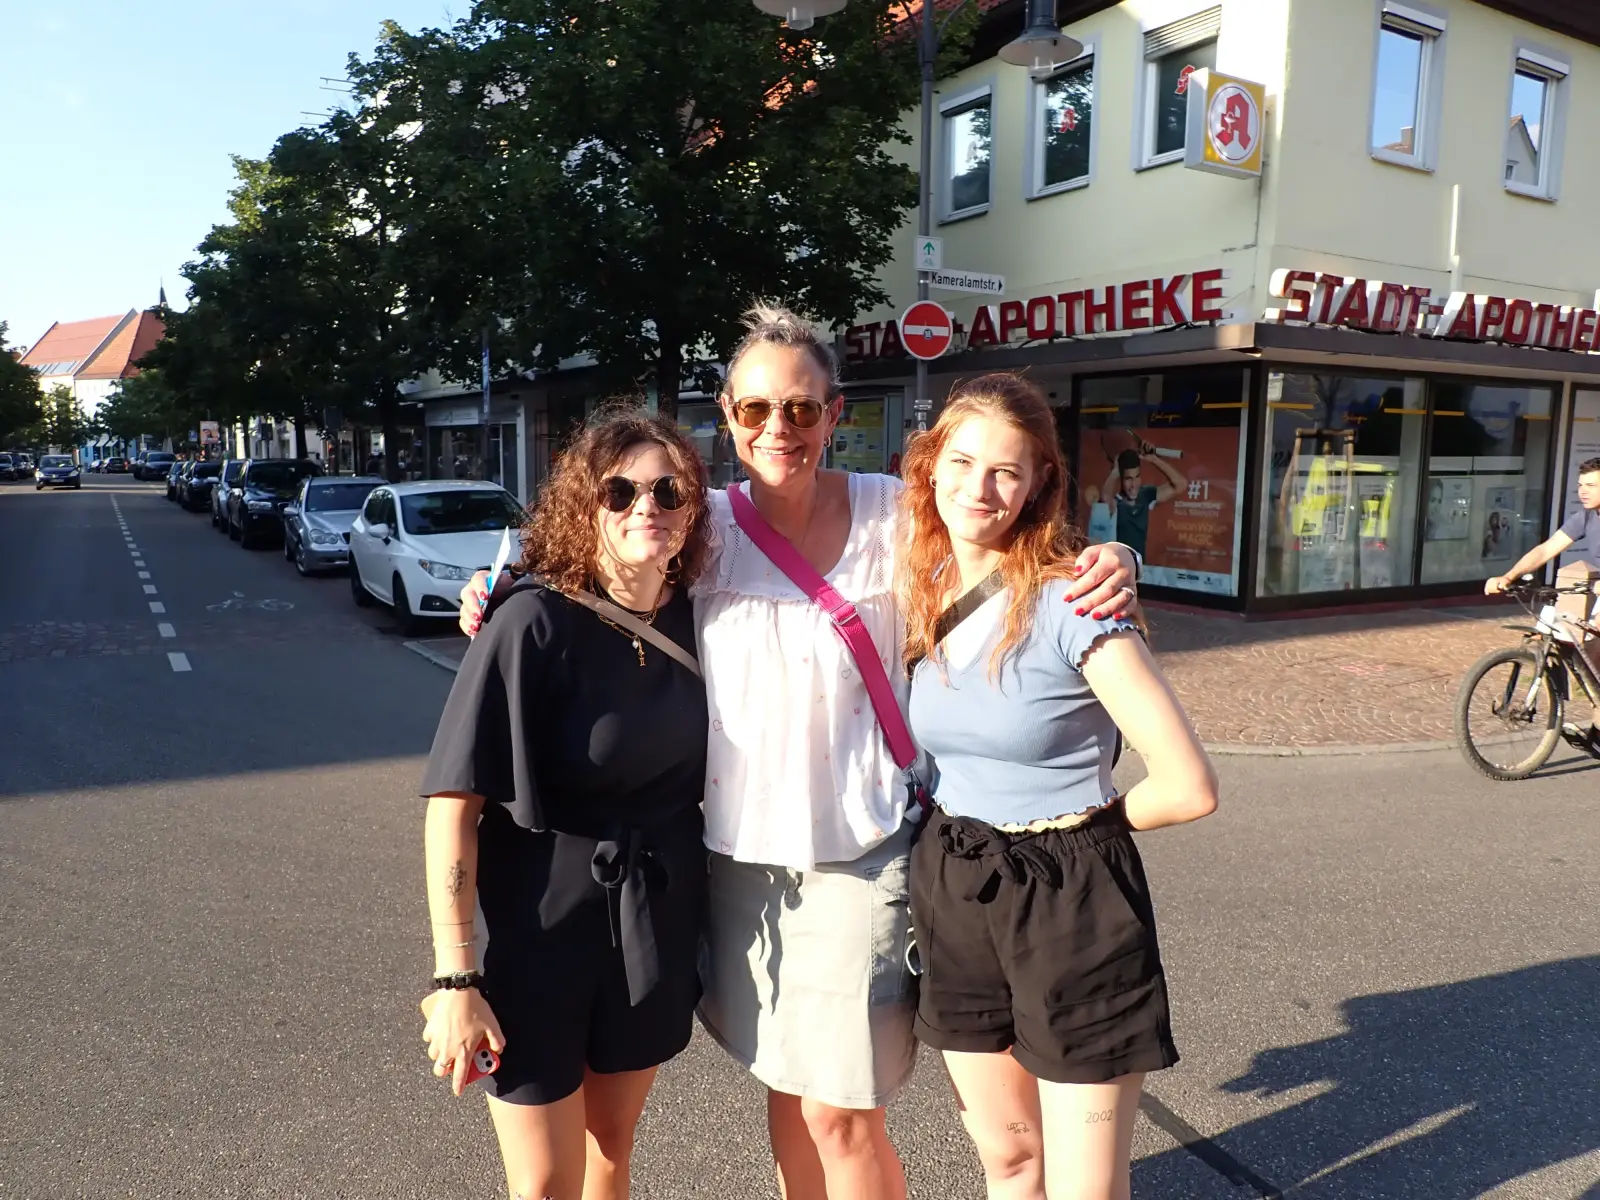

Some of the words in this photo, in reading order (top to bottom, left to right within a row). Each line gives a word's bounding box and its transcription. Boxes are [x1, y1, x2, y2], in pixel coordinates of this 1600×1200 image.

[931, 271, 997, 291] Kameralamtstr.
[844, 268, 1224, 361] STA-APOTHEKE
[1267, 268, 1600, 352] STADT-APOTHE
[1187, 479, 1209, 500] #1
[1178, 532, 1213, 546] MAGIC
[1085, 1109, 1113, 1124] 2002
